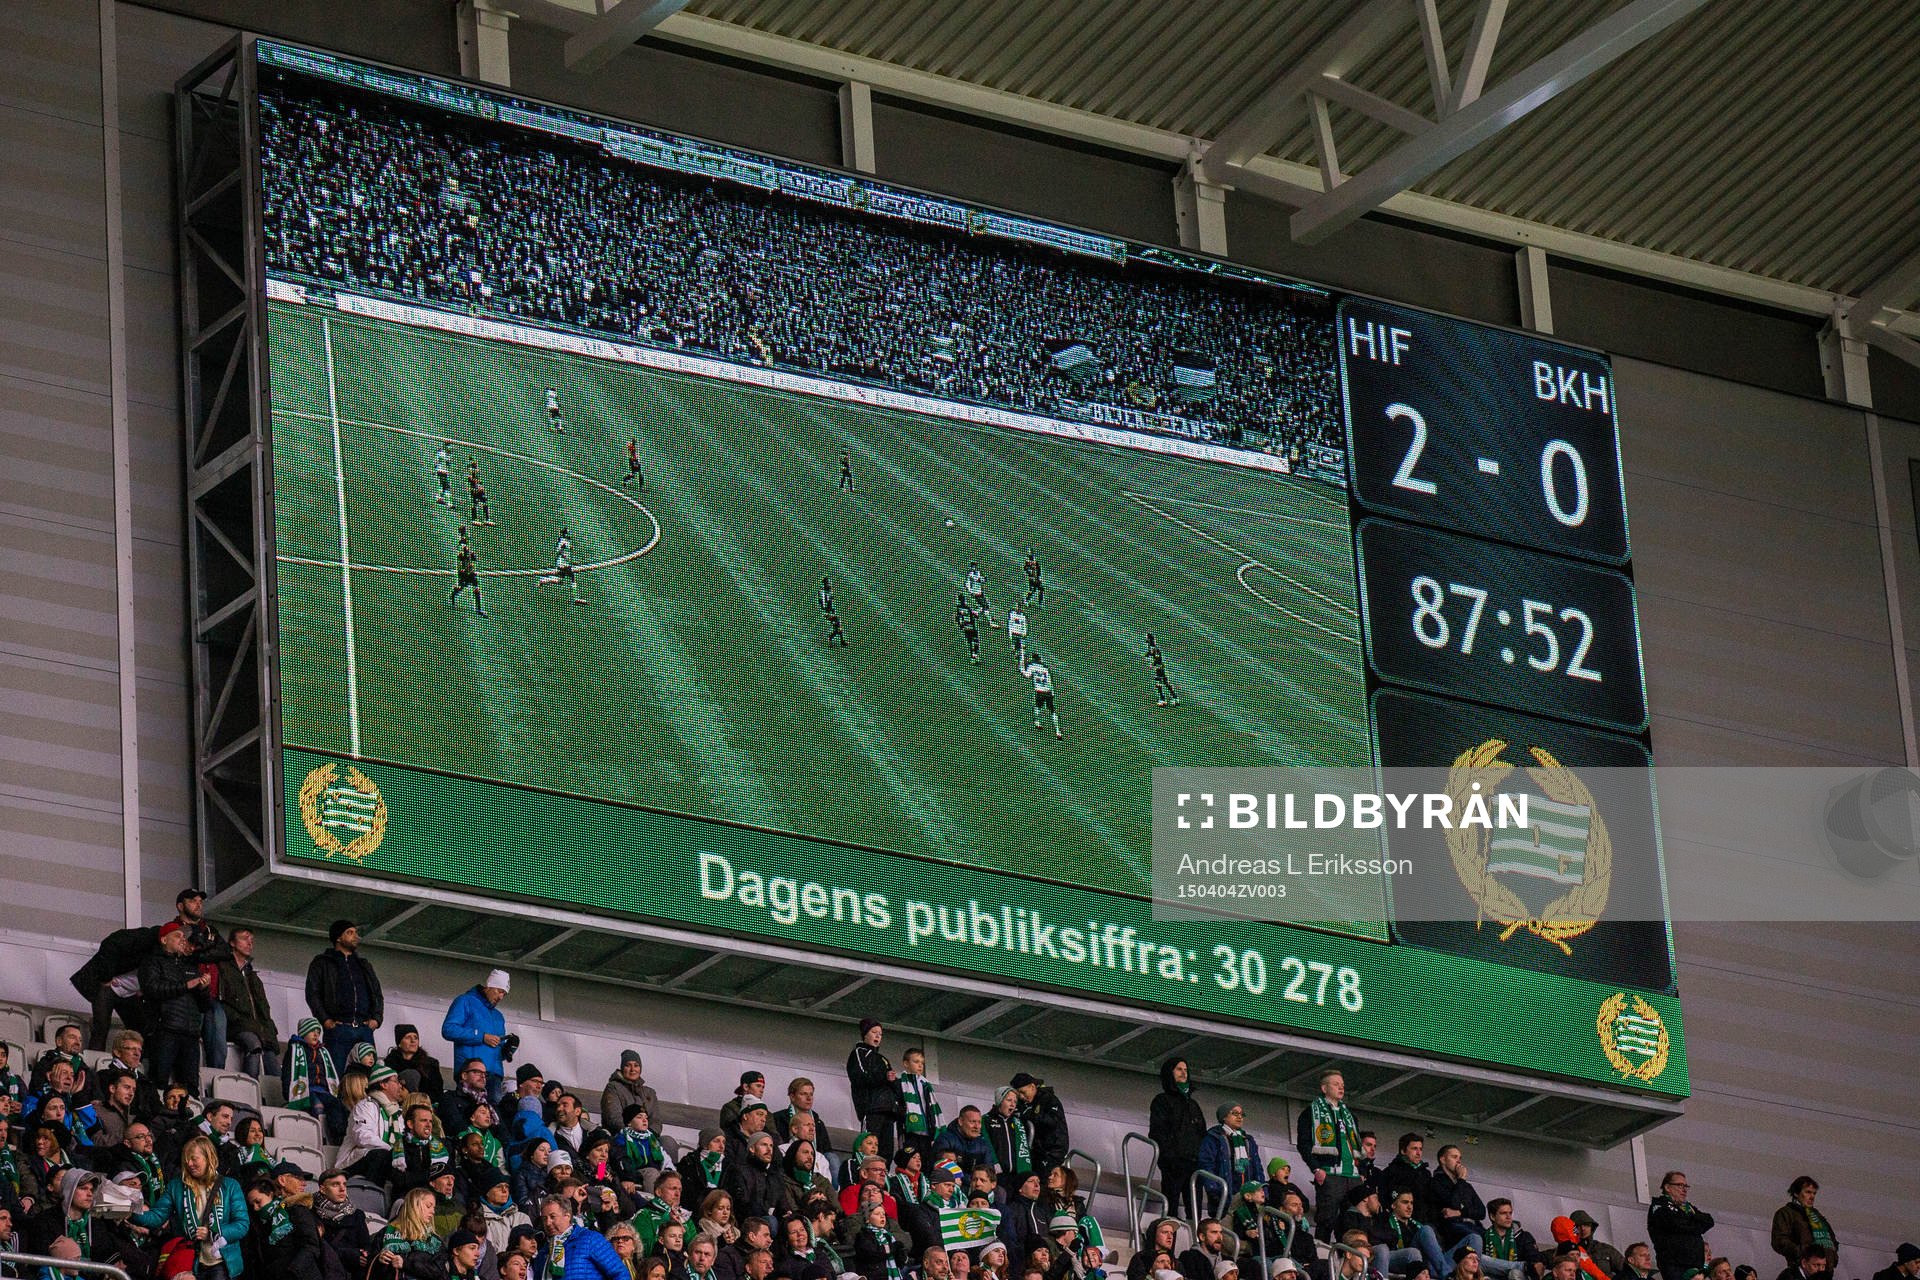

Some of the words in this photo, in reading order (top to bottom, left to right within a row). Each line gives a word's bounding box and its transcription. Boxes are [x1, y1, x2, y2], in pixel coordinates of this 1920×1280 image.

[1349, 317, 1412, 365] HIF
[1532, 361, 1610, 414] BKH
[1385, 402, 1438, 495] 2
[1540, 439, 1589, 528] 0
[1411, 575, 1603, 682] 87:52
[697, 851, 892, 929] Dagens
[906, 900, 1199, 985] publiksiffra:
[1211, 943, 1267, 996] 30
[1280, 955, 1364, 1013] 278
